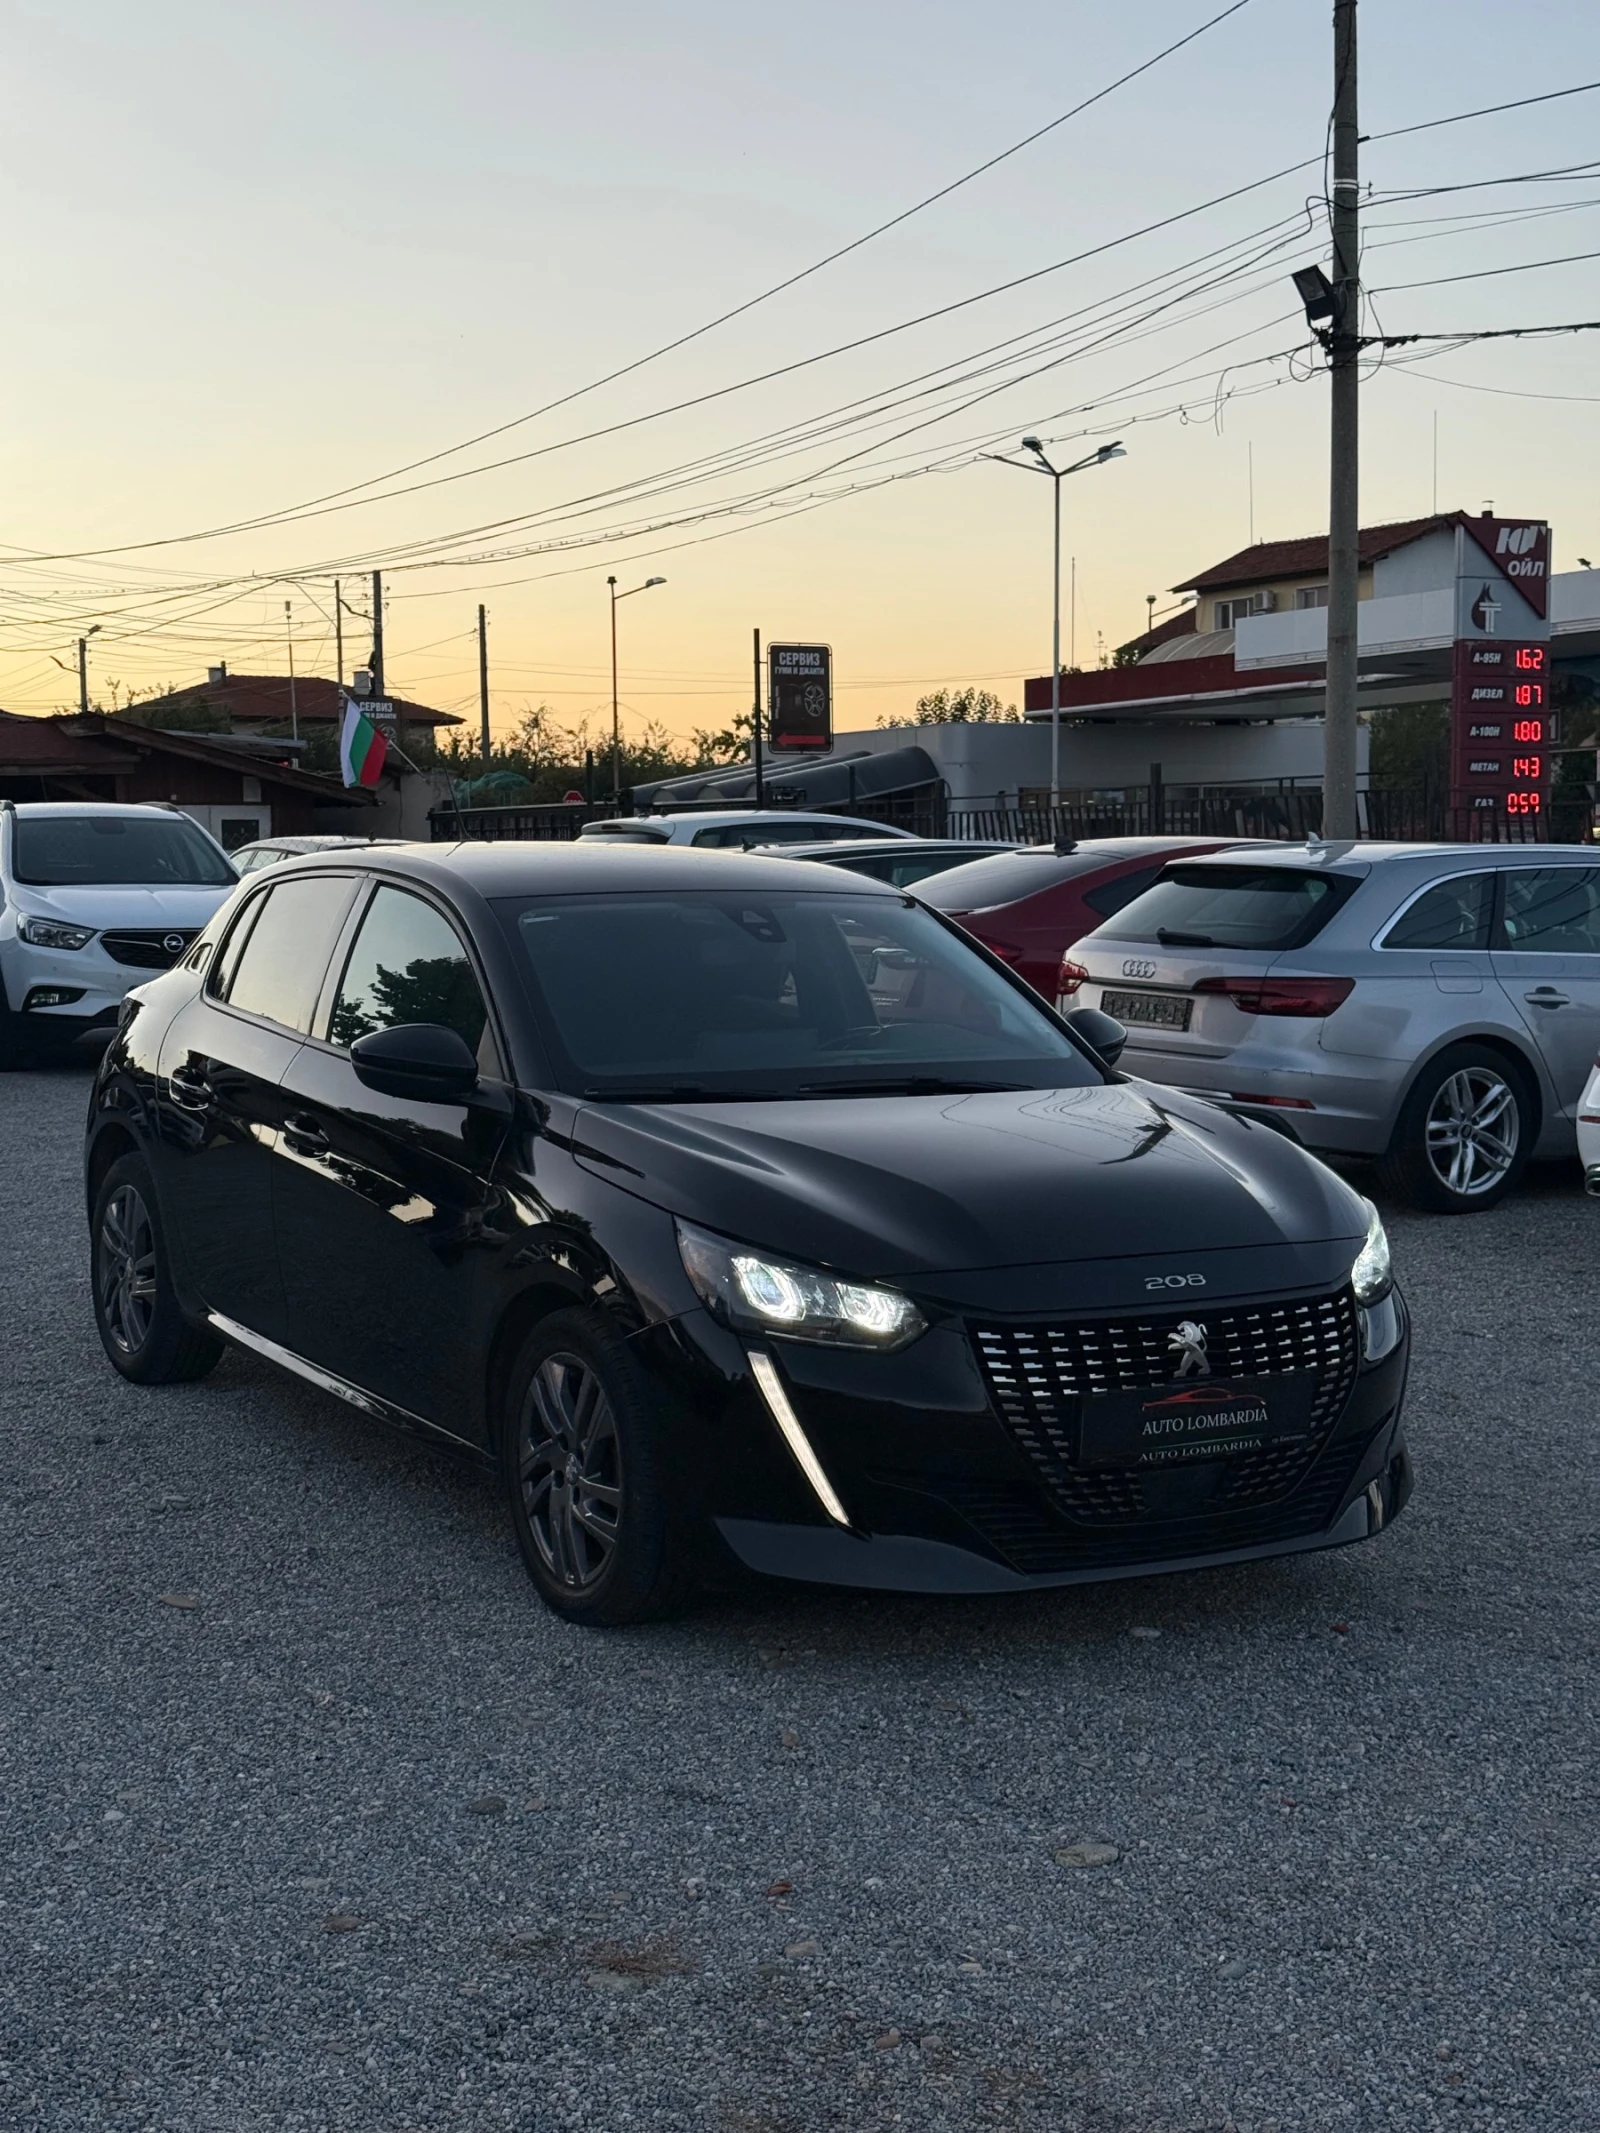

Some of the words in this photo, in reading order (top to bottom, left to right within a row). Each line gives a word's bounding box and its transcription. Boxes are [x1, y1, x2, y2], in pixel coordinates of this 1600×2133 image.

[1507, 557, 1545, 577] ОЙЛ
[779, 652, 820, 665] СЕРВИЗ
[1471, 688, 1504, 700] ДИЗЕЛ
[360, 702, 392, 712] СЕРВИЗ
[1470, 762, 1500, 772] МЕТАН
[1144, 1273, 1207, 1290] 208
[1142, 1417, 1184, 1436] AUTO
[1187, 1407, 1269, 1431] LOMBARDIA
[1138, 1449, 1178, 1462] AUTO
[1182, 1438, 1263, 1457] LOMBARDIA
